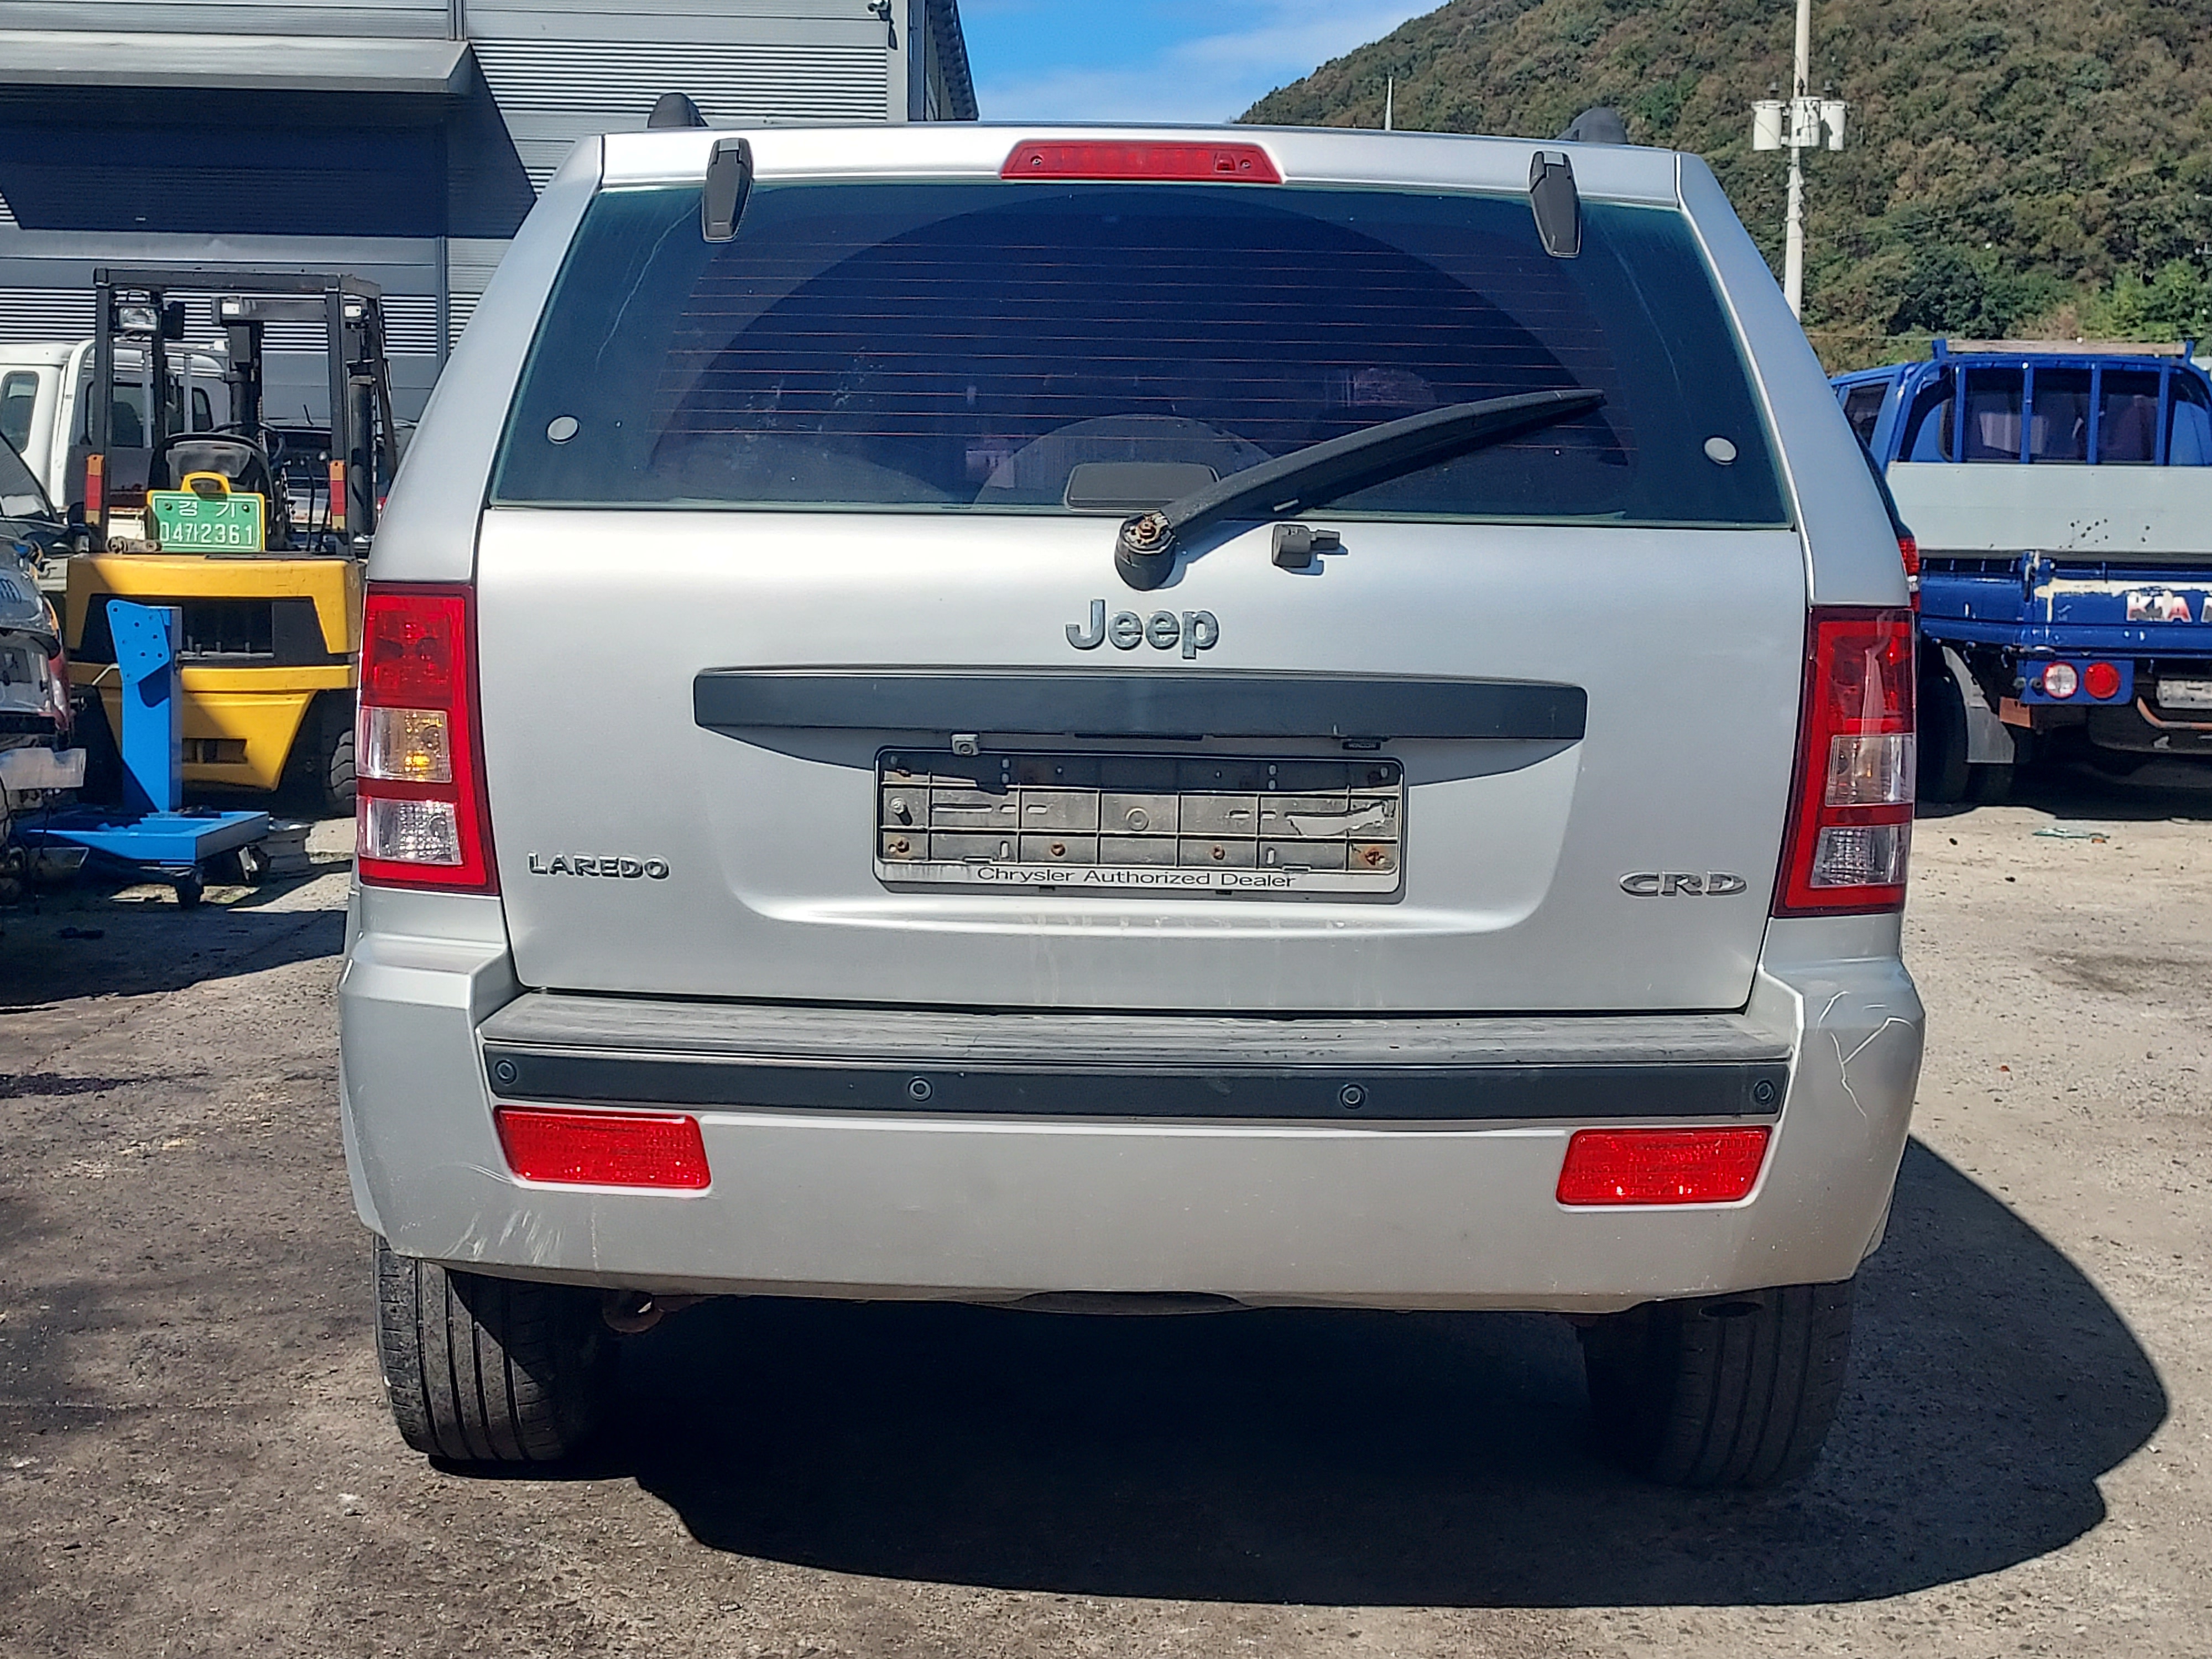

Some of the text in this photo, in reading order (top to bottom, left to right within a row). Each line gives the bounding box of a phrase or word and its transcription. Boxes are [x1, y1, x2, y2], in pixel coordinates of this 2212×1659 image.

[1065, 598, 1219, 660] Jeep
[528, 852, 670, 880] LAREDO
[977, 867, 1296, 887] Chrysler Authorized Dealer
[1619, 870, 1748, 897] CRD
